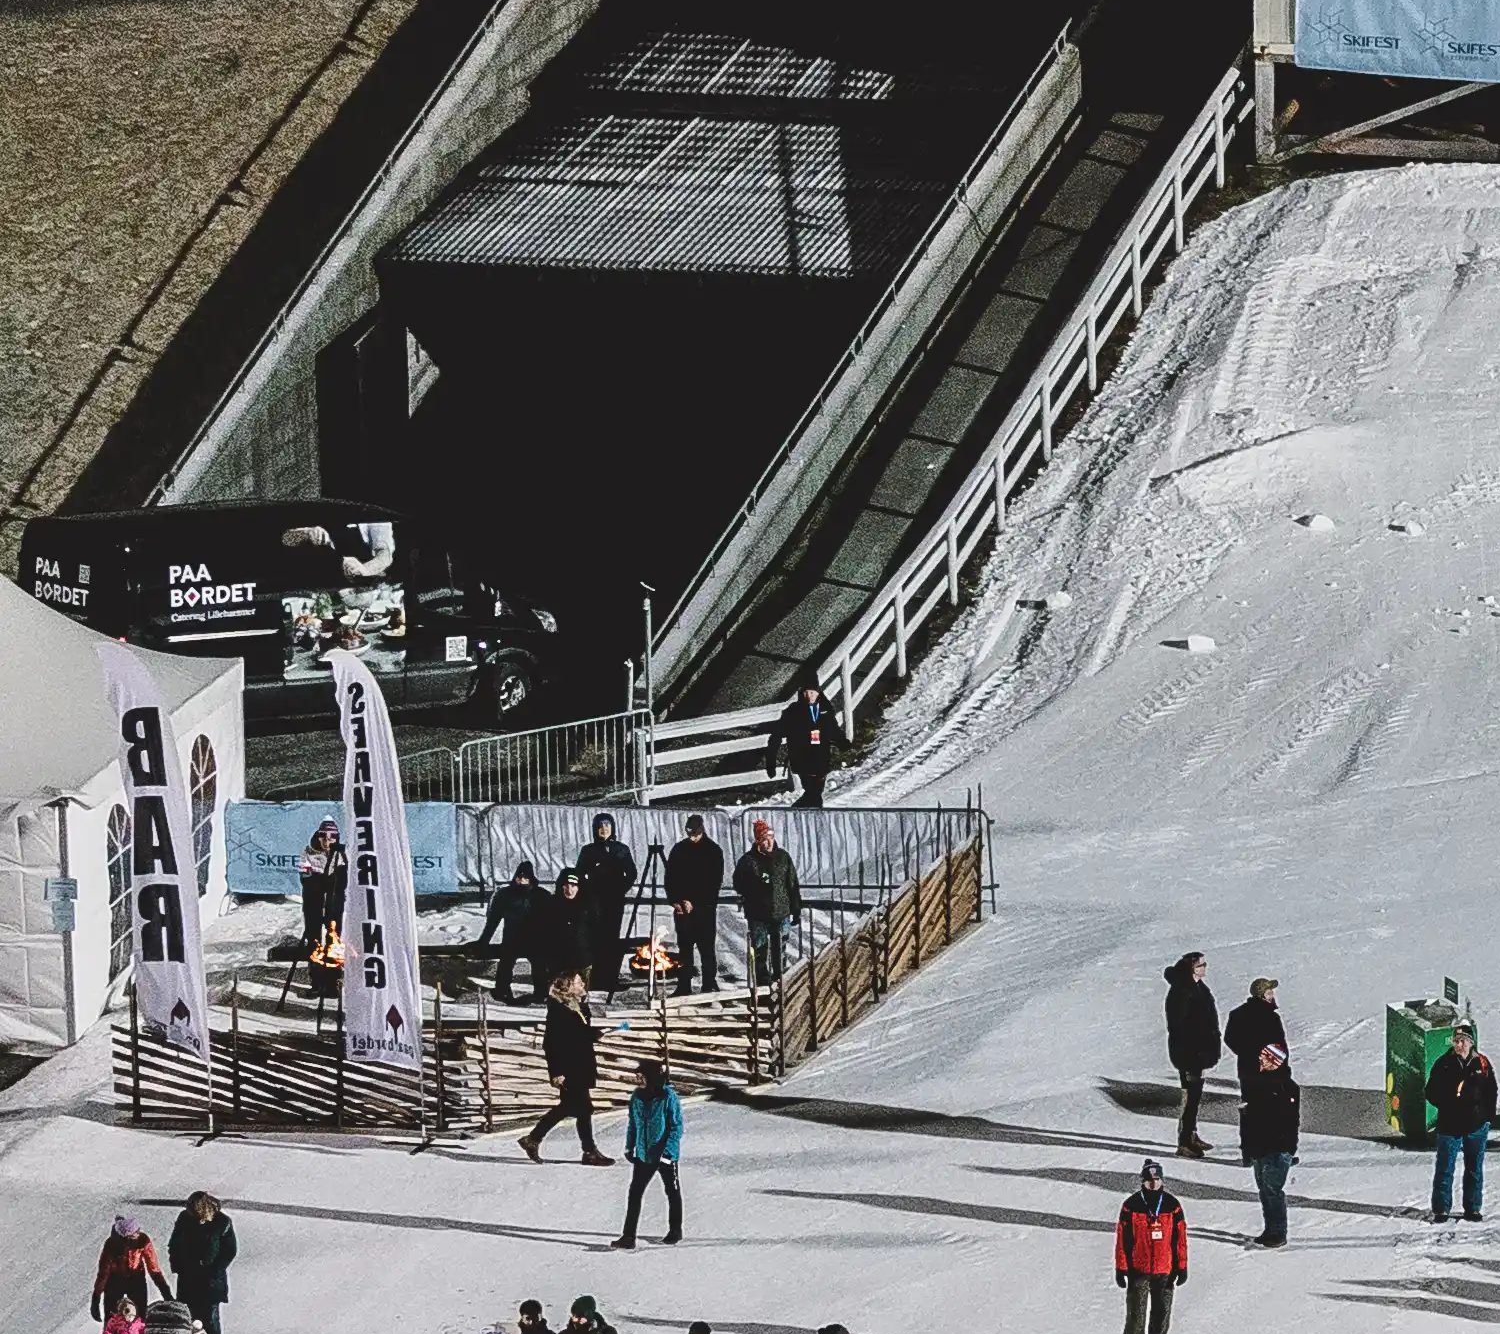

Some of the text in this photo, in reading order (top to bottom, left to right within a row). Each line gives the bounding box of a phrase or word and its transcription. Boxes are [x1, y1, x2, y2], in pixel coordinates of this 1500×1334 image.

[1343, 34, 1400, 49] SKIFEST
[35, 556, 61, 579] PAA
[169, 564, 212, 585] PAA
[34, 580, 89, 607] BORDET
[169, 582, 256, 608] BORDET
[170, 607, 257, 623] Catering Lillehammer
